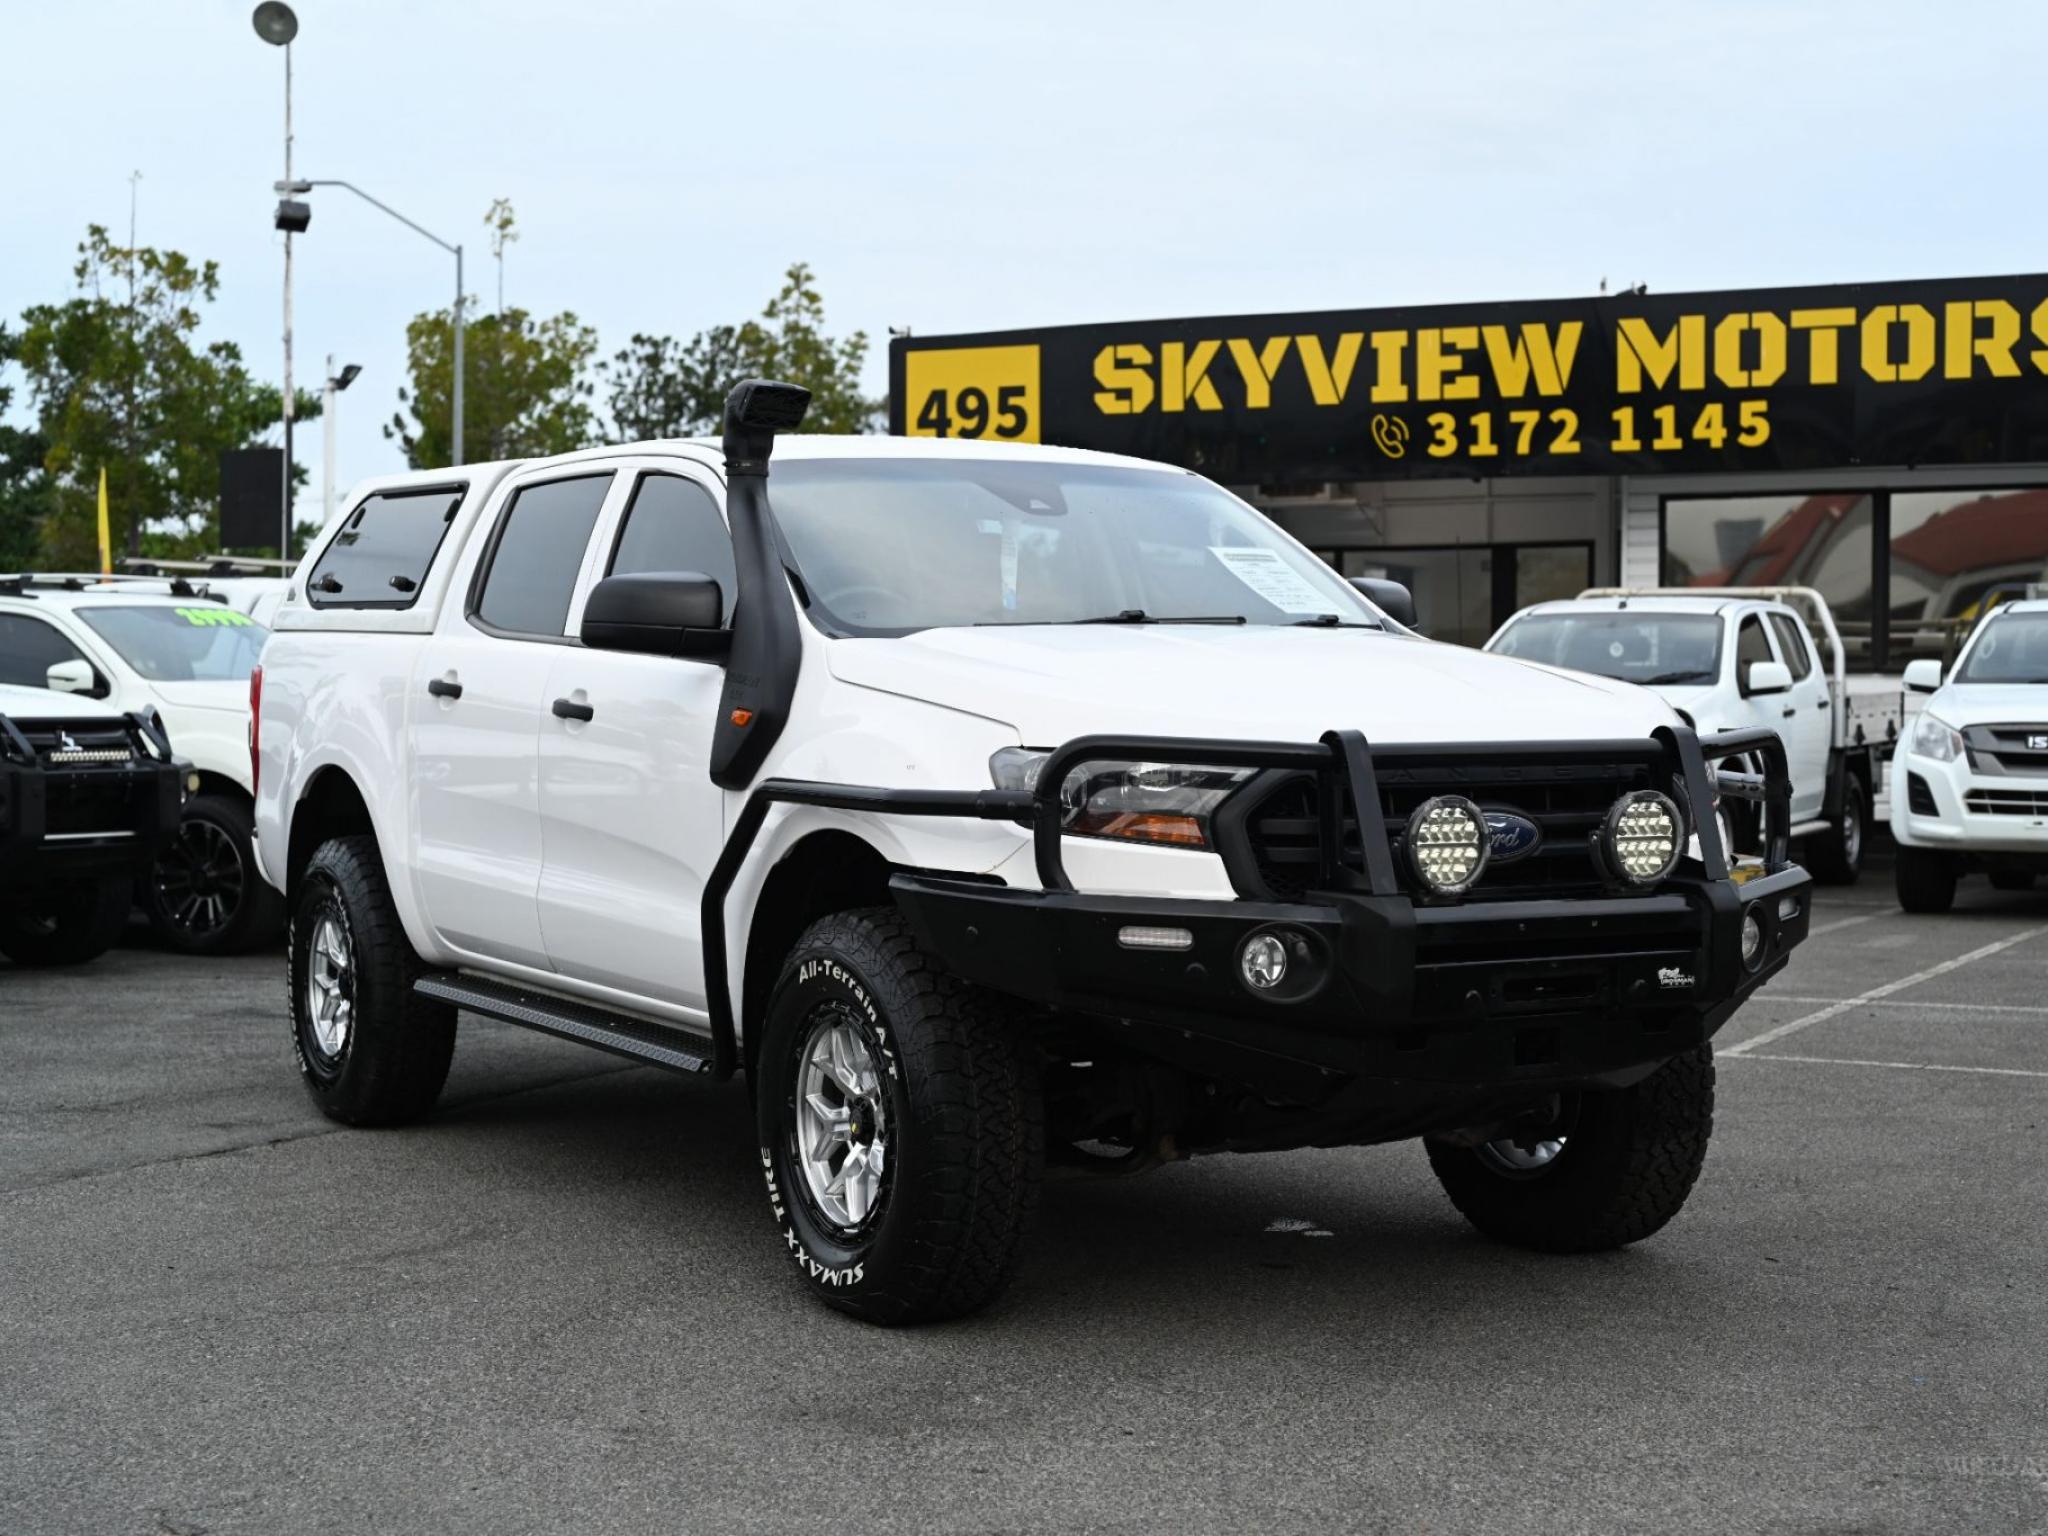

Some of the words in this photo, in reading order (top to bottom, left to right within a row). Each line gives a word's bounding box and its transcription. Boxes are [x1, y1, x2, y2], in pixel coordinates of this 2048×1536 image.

[1094, 321, 1584, 414] SKYVIEW
[1616, 297, 2048, 394] MOTOR
[917, 385, 1027, 439] 495
[1427, 408, 1581, 457] 3172
[1611, 399, 1770, 453] 1145
[1390, 764, 1618, 783] ANGER
[799, 960, 877, 1022] All-Terrain
[875, 1027, 897, 1080] A/T
[761, 1147, 785, 1222] TIRE
[783, 1227, 864, 1287] SUMAXX
